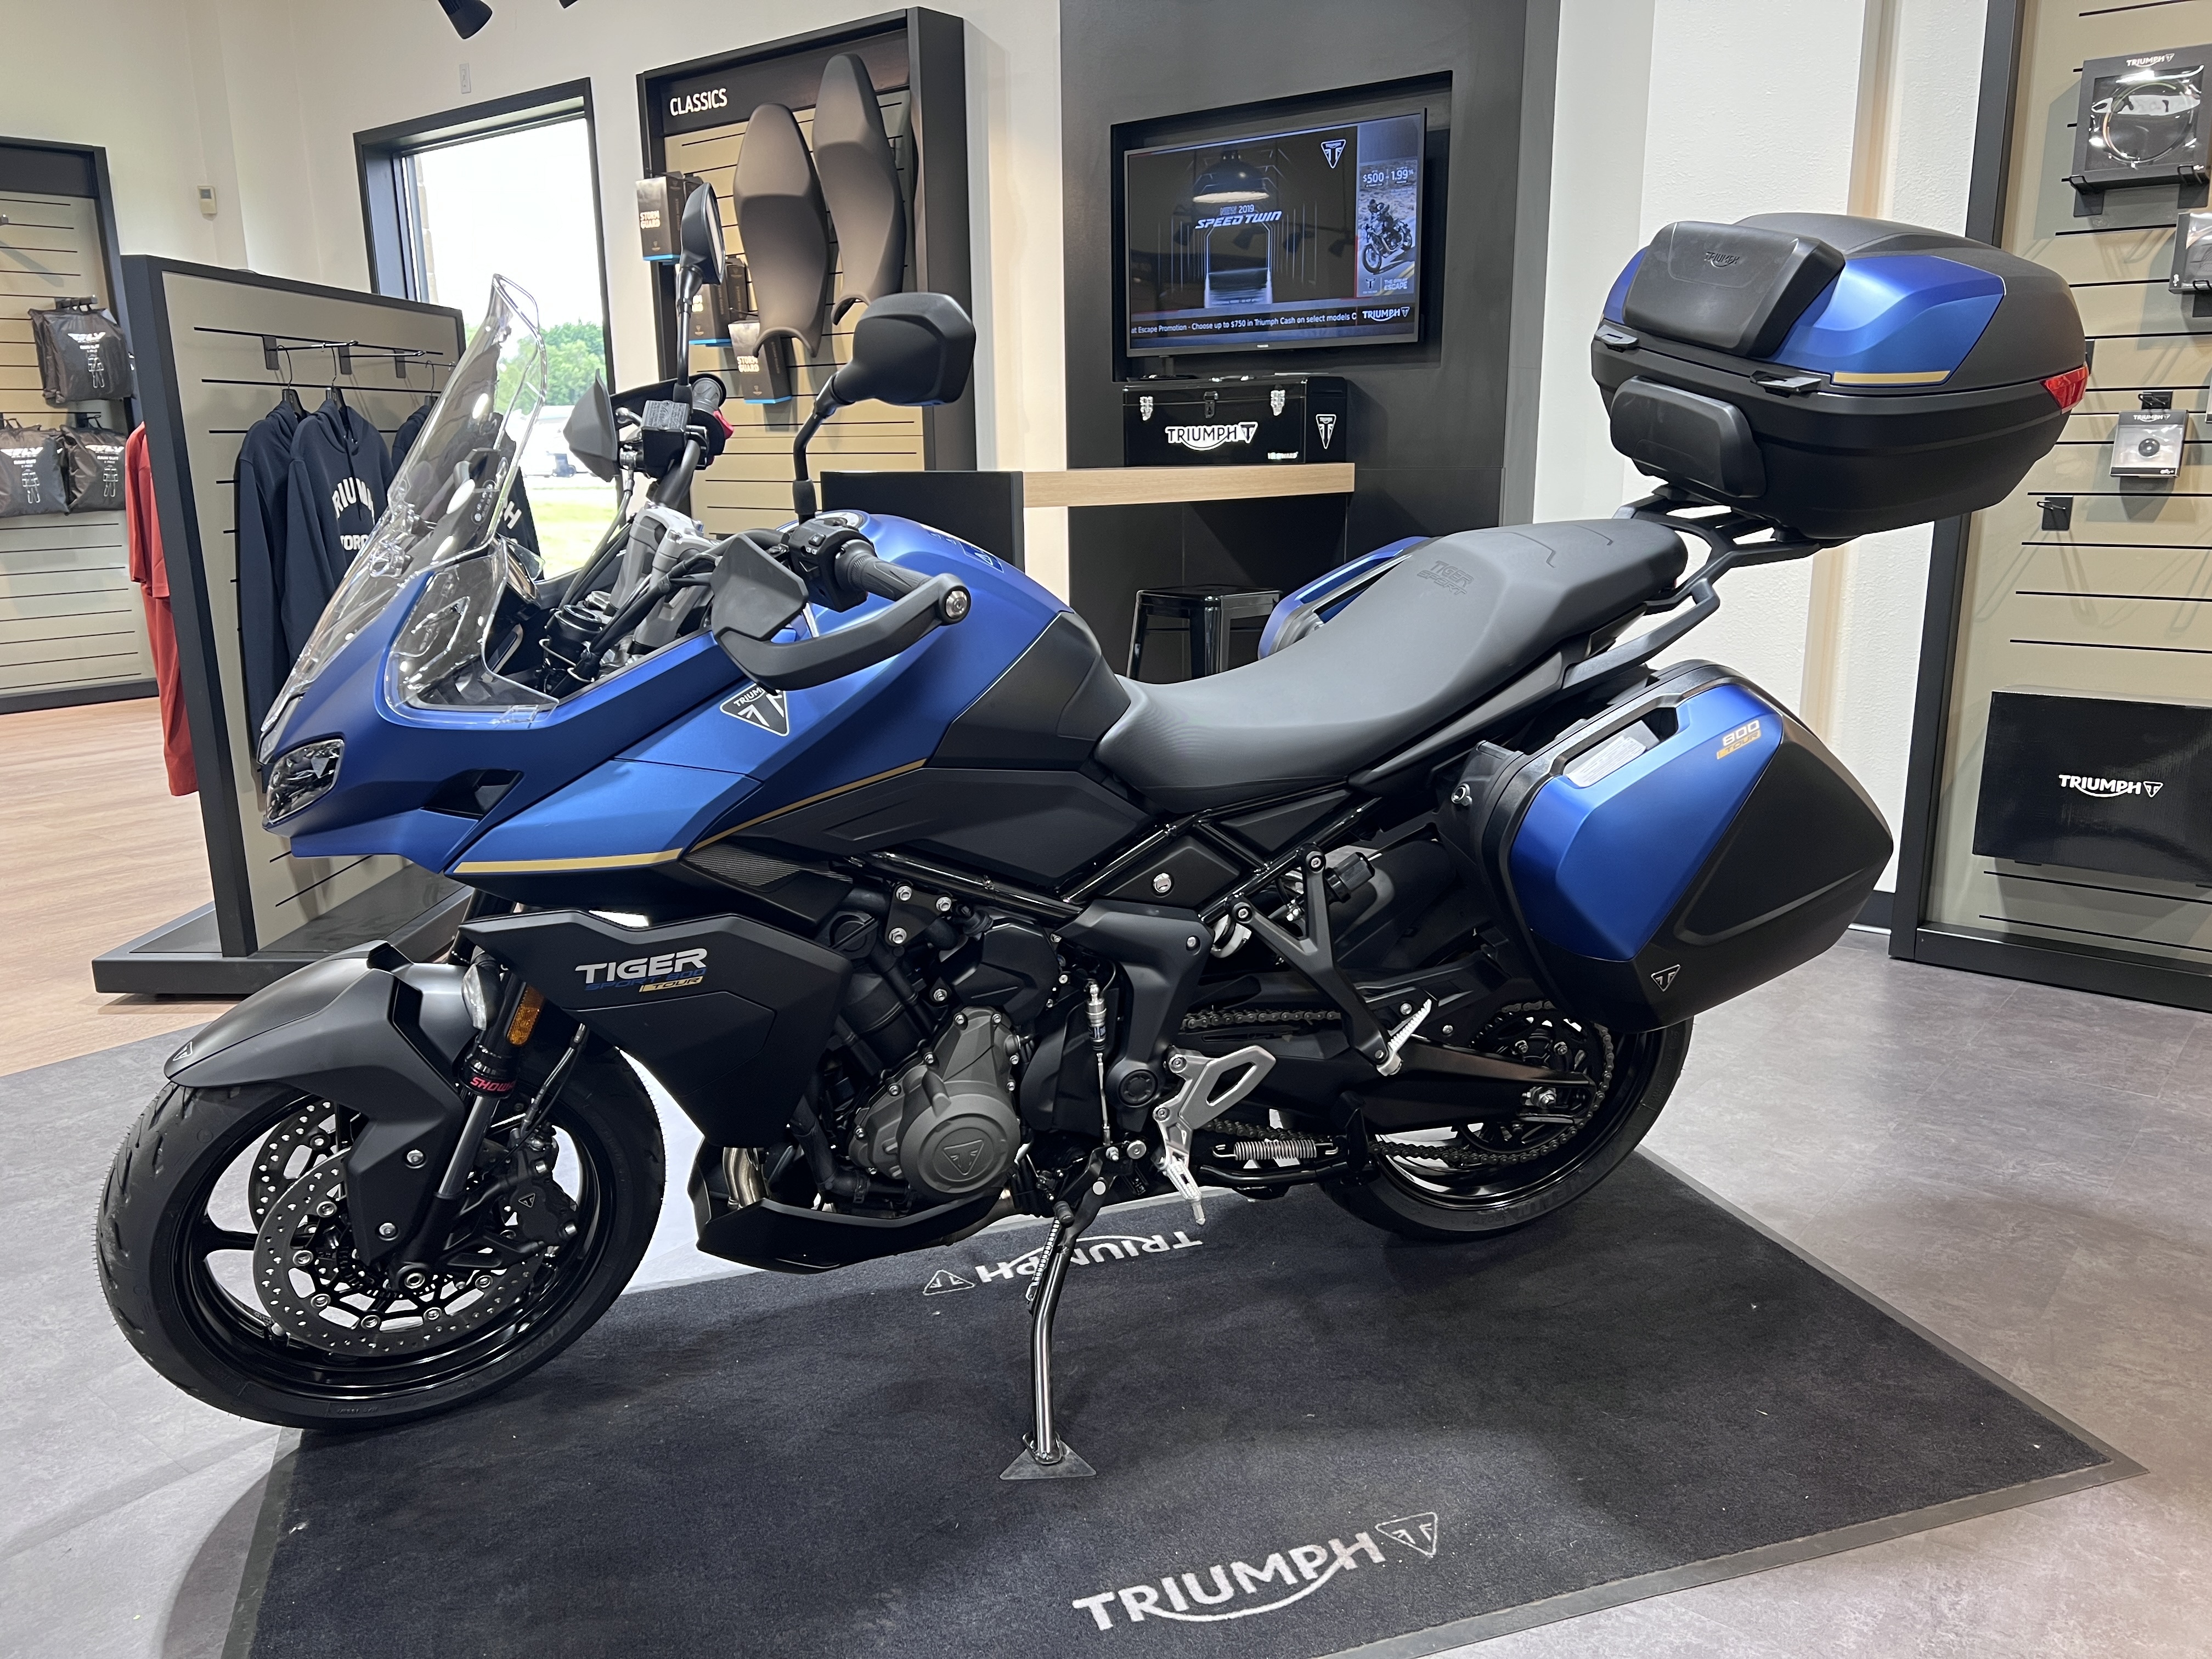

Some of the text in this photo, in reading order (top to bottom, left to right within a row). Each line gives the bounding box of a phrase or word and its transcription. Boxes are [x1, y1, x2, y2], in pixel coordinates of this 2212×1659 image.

[2126, 55, 2165, 67] TRIUMPH
[670, 88, 727, 116] CLASSICS
[1363, 172, 1384, 184] $500
[1238, 204, 1255, 213] 2019
[1195, 211, 1282, 229] SPEED TWIN
[1704, 252, 1740, 268] TRIUMPH
[1384, 281, 1408, 291] ESCAPE
[1158, 324, 1187, 332] Promotion
[1192, 322, 1213, 330] Choose
[1231, 319, 1246, 328] $750
[1254, 318, 1279, 327] Triumph
[1306, 314, 1325, 323] select
[1327, 313, 1350, 321] models
[1362, 308, 1401, 321] TRIUMPH
[2133, 414, 2163, 422] TRIUMPH
[1165, 425, 1239, 450] TRIUMPH
[1417, 570, 1467, 595] SPORT
[1430, 560, 1474, 588] TIGER
[733, 687, 765, 707] TRIUM
[1723, 720, 1759, 746] 800
[1725, 731, 1759, 752] TOUR
[2058, 774, 2142, 797] TRIUMPH
[575, 948, 707, 984] TIGER
[585, 967, 707, 991] SPORT 800
[652, 978, 699, 989] TOUR
[1072, 1532, 1386, 1630] TRIUMPH
